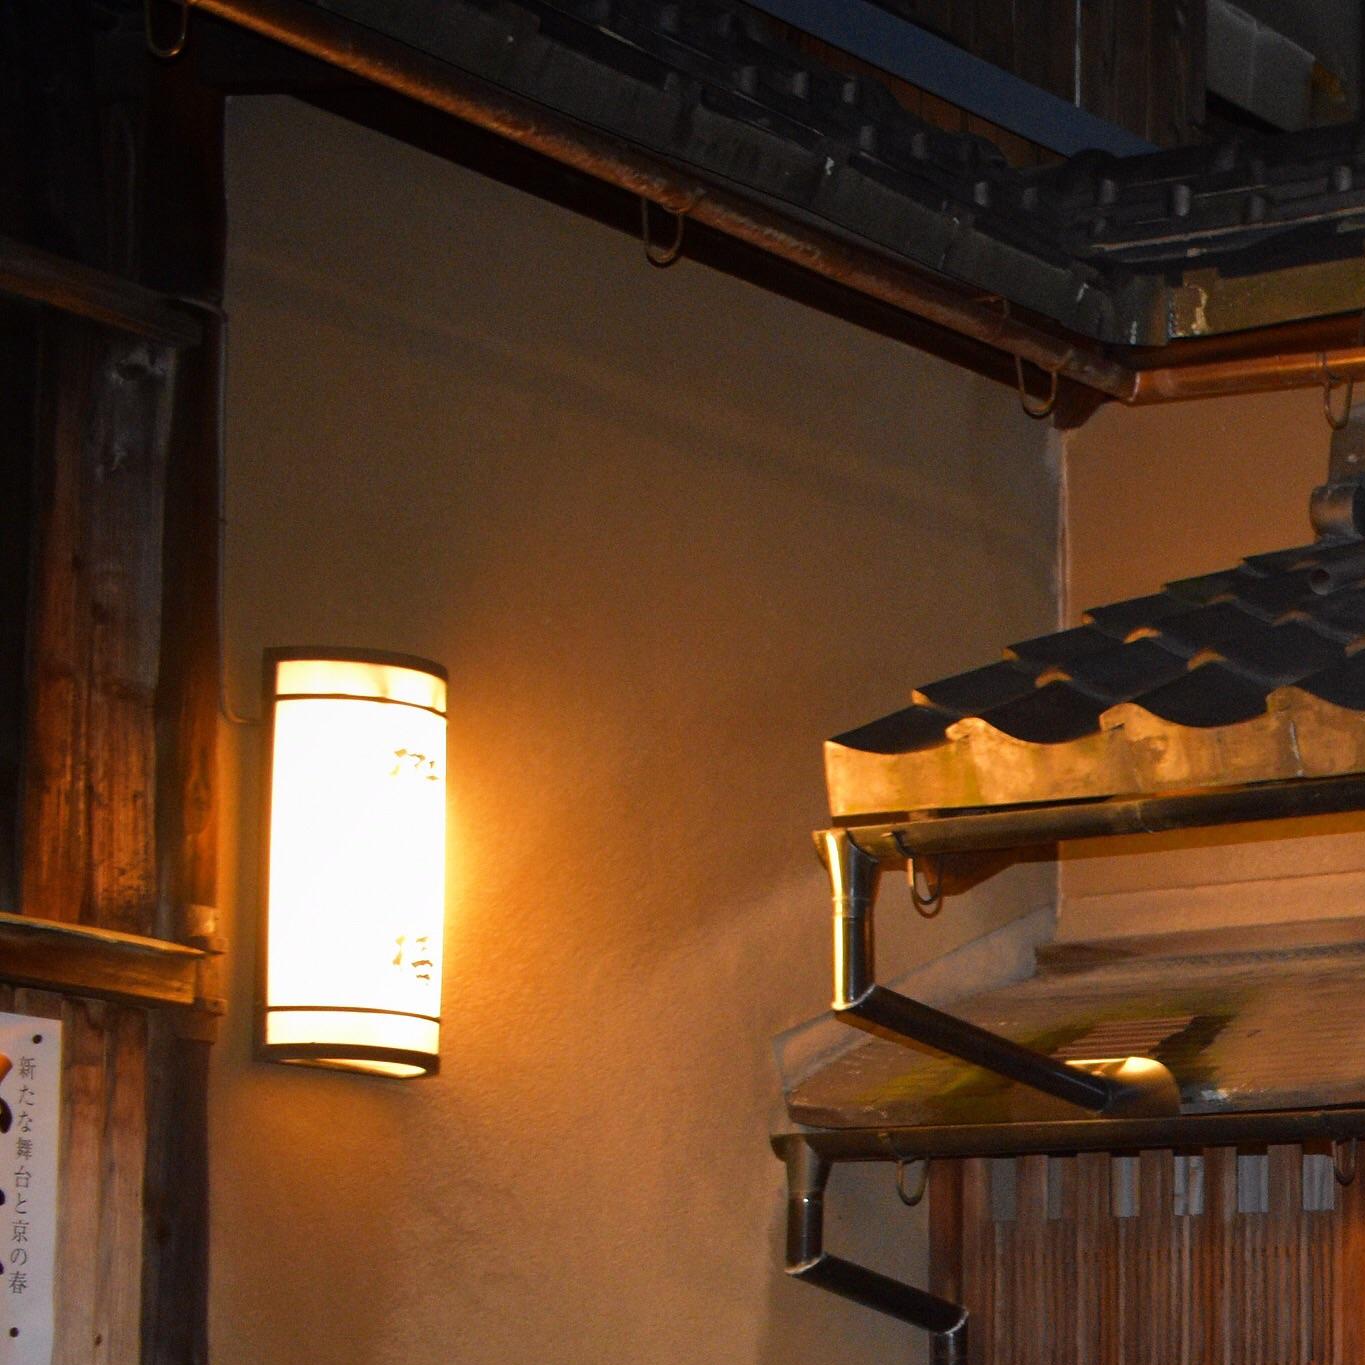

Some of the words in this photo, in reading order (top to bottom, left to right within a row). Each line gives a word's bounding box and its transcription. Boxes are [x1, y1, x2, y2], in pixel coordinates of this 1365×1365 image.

[8, 1056, 37, 1295] 新たな舞台と京の春
